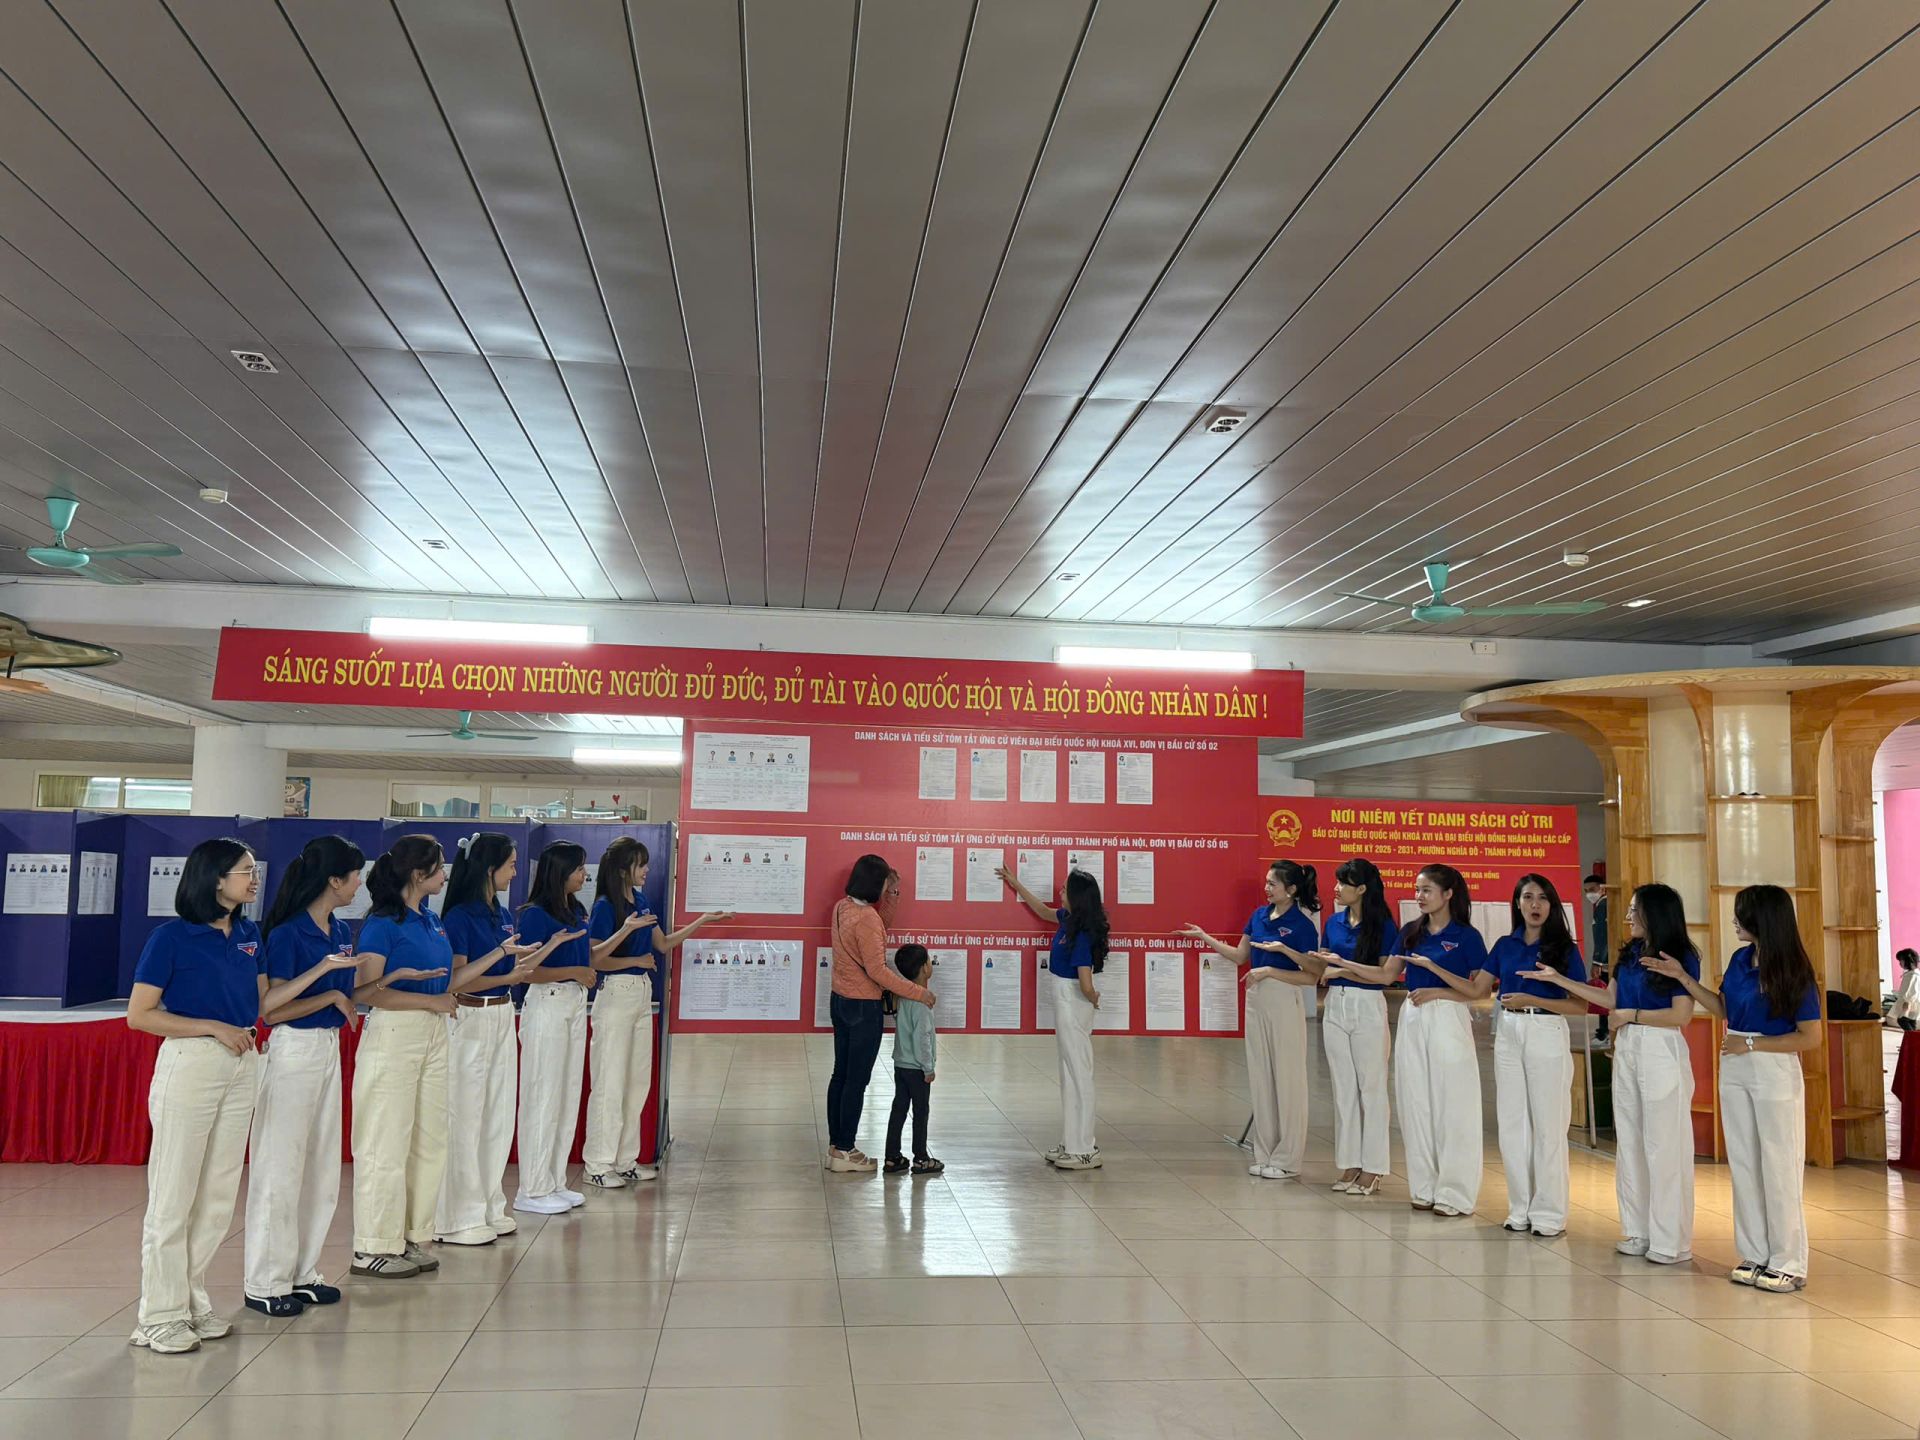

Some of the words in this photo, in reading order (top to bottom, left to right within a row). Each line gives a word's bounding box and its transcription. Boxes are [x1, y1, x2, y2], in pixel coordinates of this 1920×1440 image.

[263, 647, 329, 684] SÁNG
[333, 647, 396, 687] SUỐT
[399, 658, 445, 695] LỰA
[451, 663, 517, 698] CHỌN
[521, 660, 603, 695] NHỮNG
[608, 663, 679, 698] NGƯỜI
[684, 662, 716, 700] ĐỦ
[721, 667, 768, 705] ĐỨC,
[773, 665, 804, 704] ĐỦ
[810, 671, 847, 705] TÀI
[852, 673, 897, 707] VÀO
[902, 671, 960, 709] QUỐC
[964, 677, 1003, 716] HỘI
[1008, 679, 1037, 711] VÀ
[1043, 679, 1080, 719] HỘI
[1086, 676, 1145, 715] ĐỒNG
[1149, 684, 1209, 717] NHÂN
[1214, 685, 1258, 719] DÂN
[854, 731, 877, 741] DANH
[878, 730, 900, 742] SÁCH
[901, 731, 912, 742] VÀ
[913, 731, 931, 743] TIỂU
[932, 731, 944, 743] SỬ
[945, 733, 962, 744] TÓM
[964, 732, 978, 744] TẮT
[979, 733, 995, 745] ỨNG
[997, 734, 1008, 745] CỬ
[1010, 735, 1028, 746] VIÊN
[1029, 738, 1042, 748] ĐẠI
[1044, 735, 1062, 746] BIỂU
[1063, 736, 1085, 748] QUỐC
[1086, 738, 1099, 749] HỘI
[1140, 739, 1156, 749] ĐƠN
[1157, 740, 1165, 751] VỊ
[1184, 739, 1195, 750] CỬ
[1197, 739, 1207, 750] SỐ
[1208, 742, 1218, 751] 02
[1331, 808, 1355, 824] NƠI
[1359, 808, 1396, 825] NIÊM
[1399, 808, 1424, 826] YẾT
[1428, 812, 1466, 827] DANH
[1470, 811, 1506, 828] SÁCH
[1510, 810, 1530, 829] CỬ
[1531, 815, 1553, 829] TRI
[840, 831, 863, 841] DANH
[864, 830, 885, 842] SÁCH
[887, 832, 898, 842] VÀ
[899, 830, 917, 842] TIỂU
[919, 831, 930, 843] SỬ
[931, 833, 949, 843] TÓM
[950, 832, 965, 844] TẮT
[966, 833, 983, 844] ỨNG
[984, 833, 996, 845] CỬ
[997, 835, 1015, 845] VIÊN
[1017, 836, 1030, 847] ĐẠI
[1032, 834, 1050, 845] BIỂU
[1052, 836, 1073, 846] HĐND
[1075, 836, 1100, 847] THÀNH
[1102, 835, 1118, 847] PHỐ
[1120, 836, 1130, 847] HÀ
[1132, 837, 1148, 849] NỘI,
[1150, 838, 1166, 848] ĐƠN
[1167, 839, 1176, 850] VỊ
[1195, 837, 1206, 848] CỬ
[1207, 837, 1217, 849] SỐ
[1219, 840, 1229, 849] 05
[897, 932, 915, 944] TIỂU
[916, 932, 928, 944] SỬ
[929, 934, 947, 945] TÓM
[949, 934, 964, 945] TẮT
[965, 934, 982, 945] ỨNG
[983, 934, 995, 946] CỬ
[995, 936, 1014, 946] VIÊN
[1015, 938, 1029, 948] ĐẠI
[1031, 935, 1049, 946] BIỂU
[1108, 936, 1132, 948] NGHĨA
[1134, 937, 1147, 949] ĐÔ,
[1149, 938, 1165, 948] ĐƠN
[1167, 939, 1175, 950] VỊ
